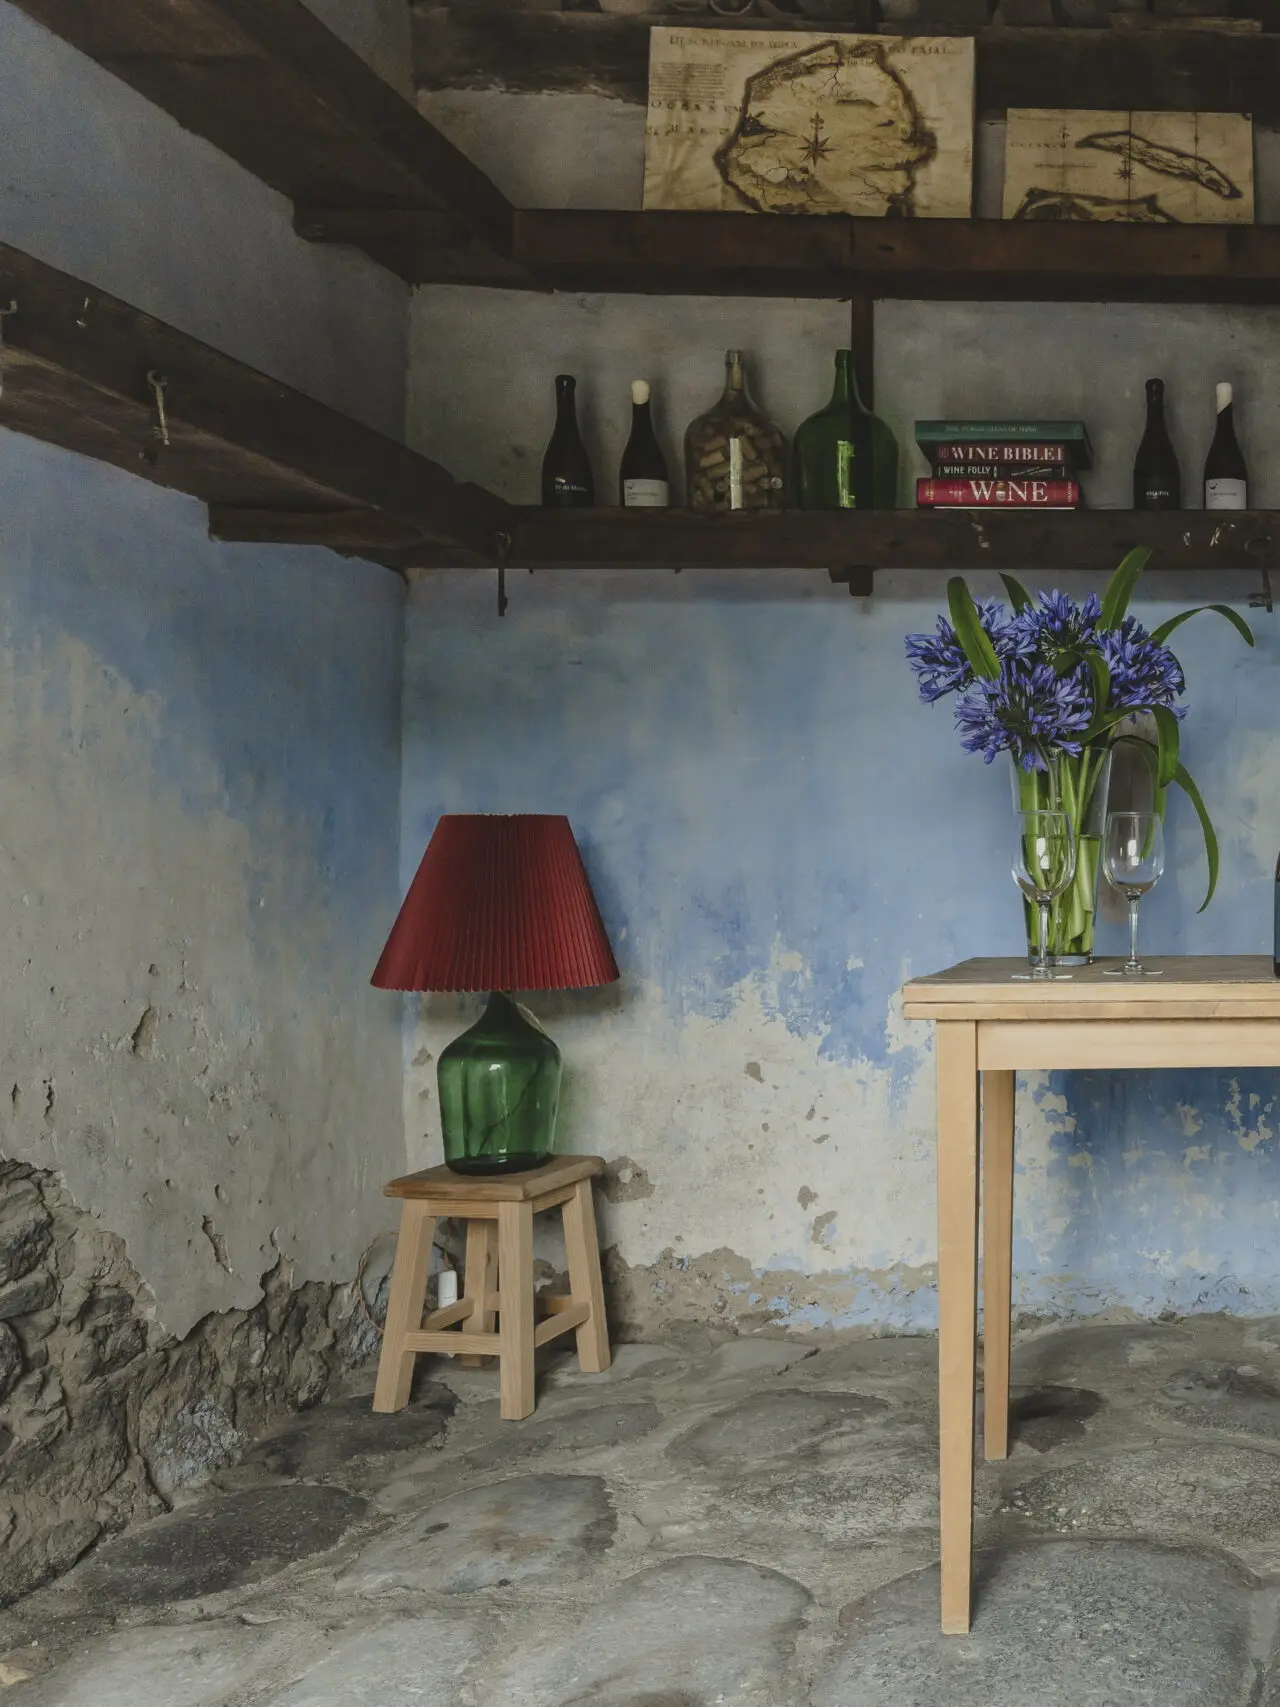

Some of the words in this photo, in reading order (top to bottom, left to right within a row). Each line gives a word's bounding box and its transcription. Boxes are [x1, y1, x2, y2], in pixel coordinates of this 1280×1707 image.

[951, 447, 998, 460] WINE
[943, 466, 964, 475] WINE
[967, 466, 991, 475] FOLLY
